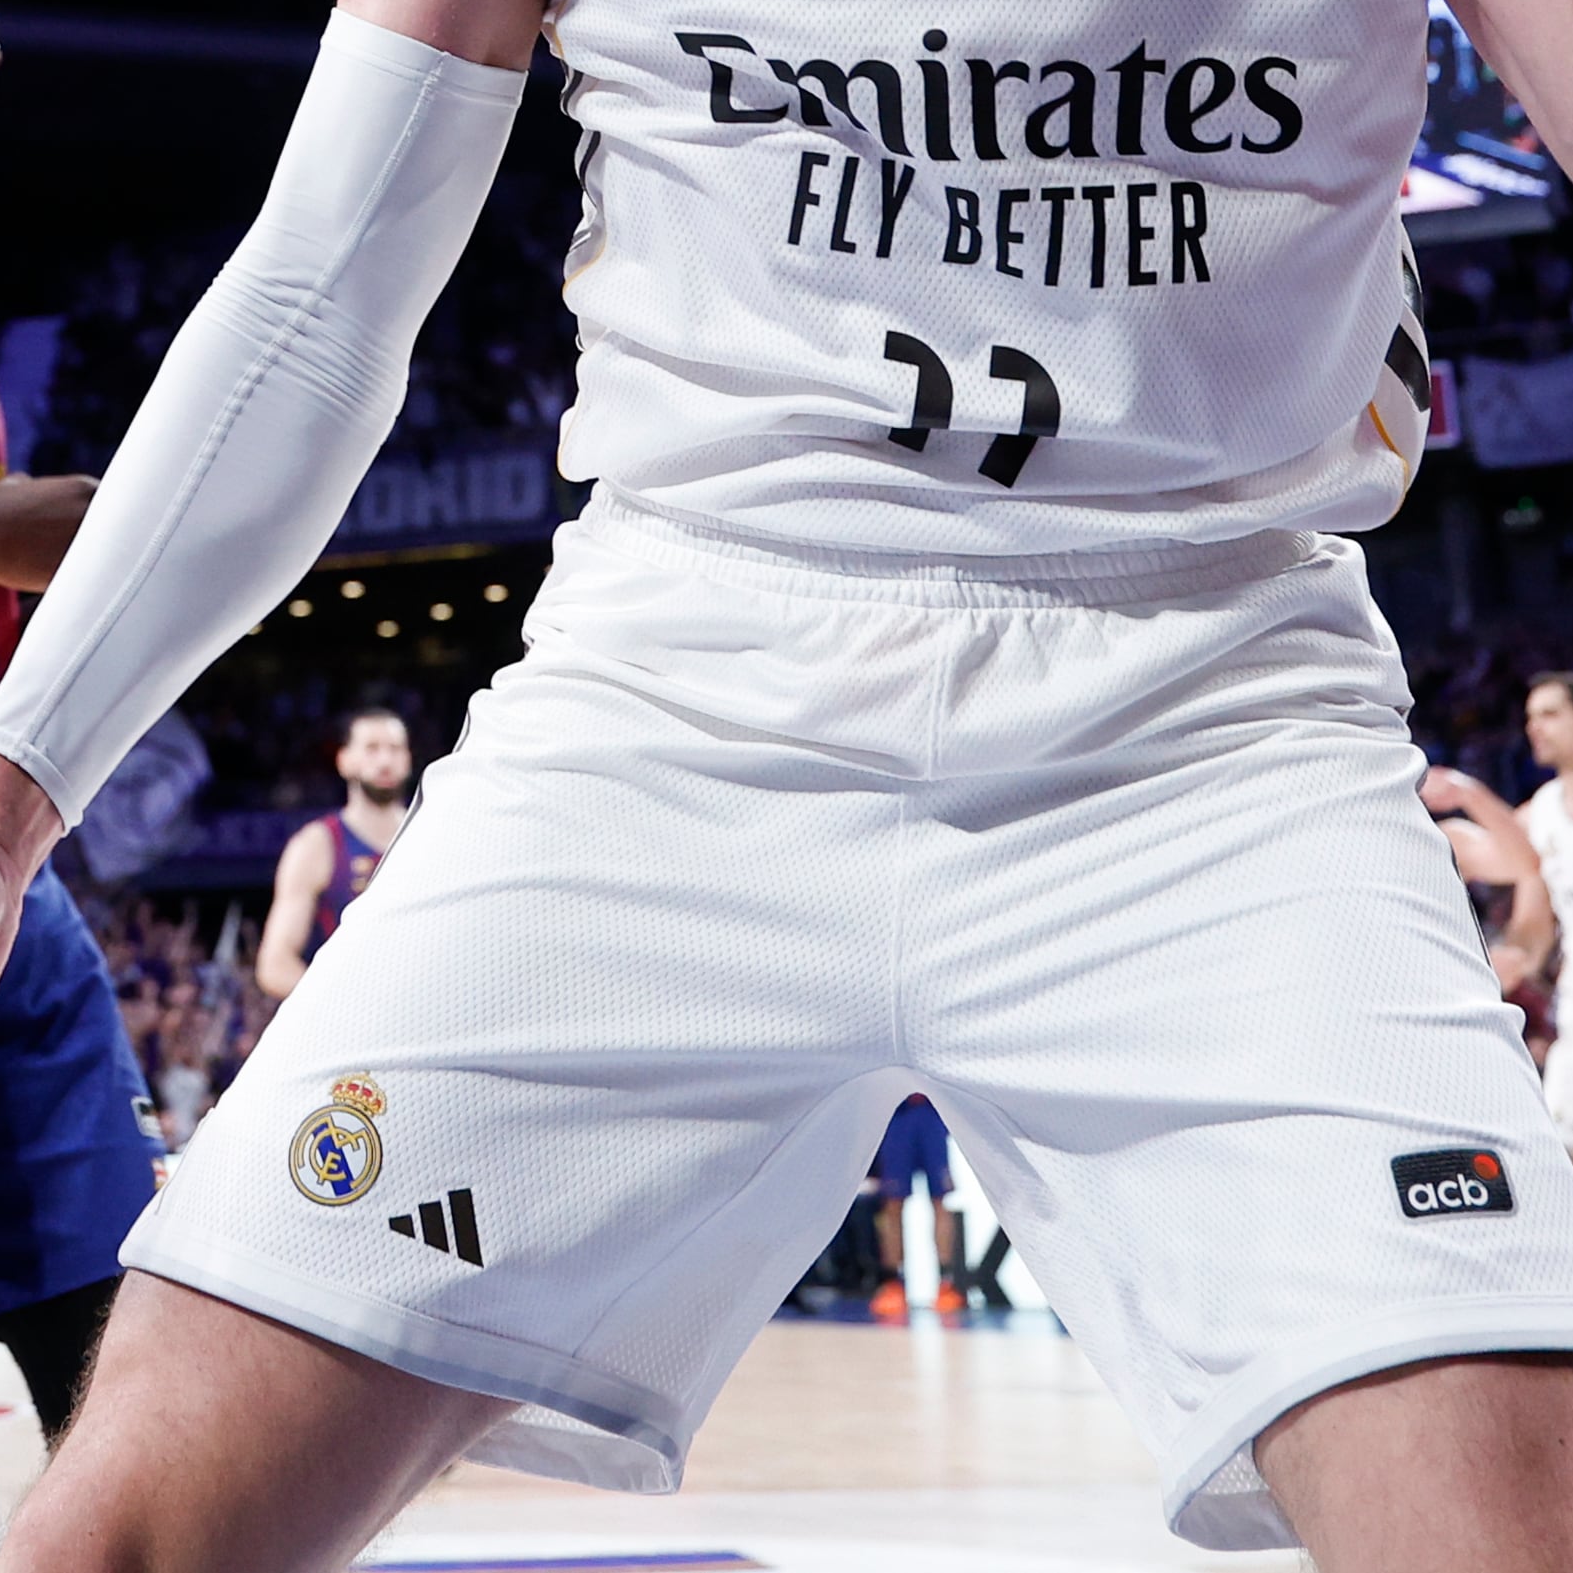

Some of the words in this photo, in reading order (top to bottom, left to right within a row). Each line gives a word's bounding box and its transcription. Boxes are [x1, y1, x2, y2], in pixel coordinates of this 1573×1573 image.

[674, 28, 1304, 161] Emirates
[788, 150, 916, 258] FLY
[942, 180, 1211, 289] BETTER
[1408, 1173, 1489, 1211] acb
